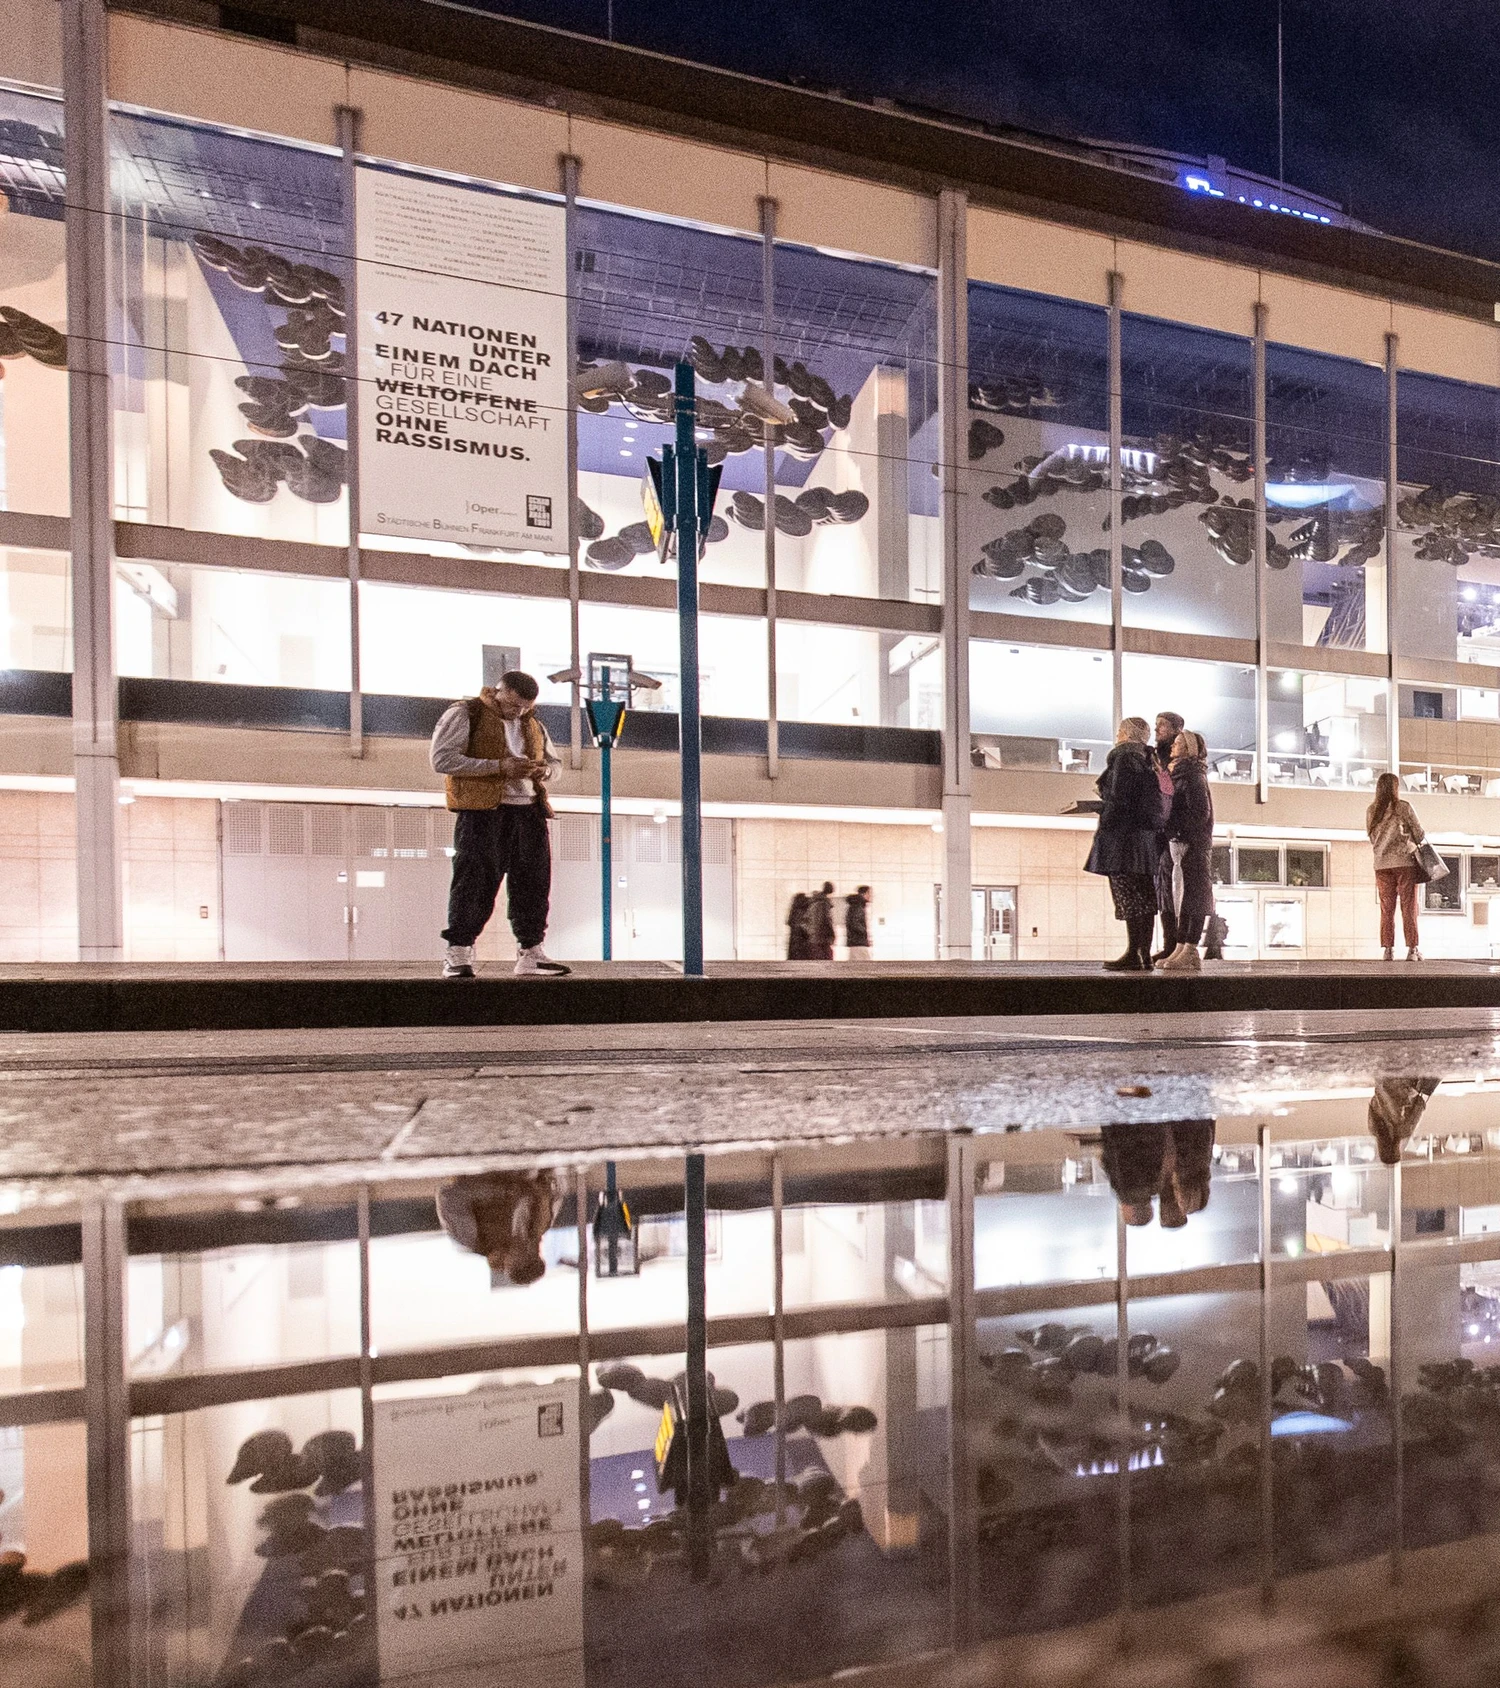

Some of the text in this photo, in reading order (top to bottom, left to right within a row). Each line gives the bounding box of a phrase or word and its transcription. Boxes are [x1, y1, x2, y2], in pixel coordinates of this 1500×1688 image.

[375, 311, 537, 348] 47 NATIONEN
[375, 343, 537, 381] EINEM DACH
[472, 342, 551, 367] UNTER
[391, 362, 493, 391] FÜR EINE
[375, 377, 538, 413] WELTOFFENE
[375, 395, 551, 431] GESELLSCHAFT
[375, 412, 448, 434] OHNE
[375, 428, 531, 462] RASSISMUS.
[471, 503, 500, 515] Oper
